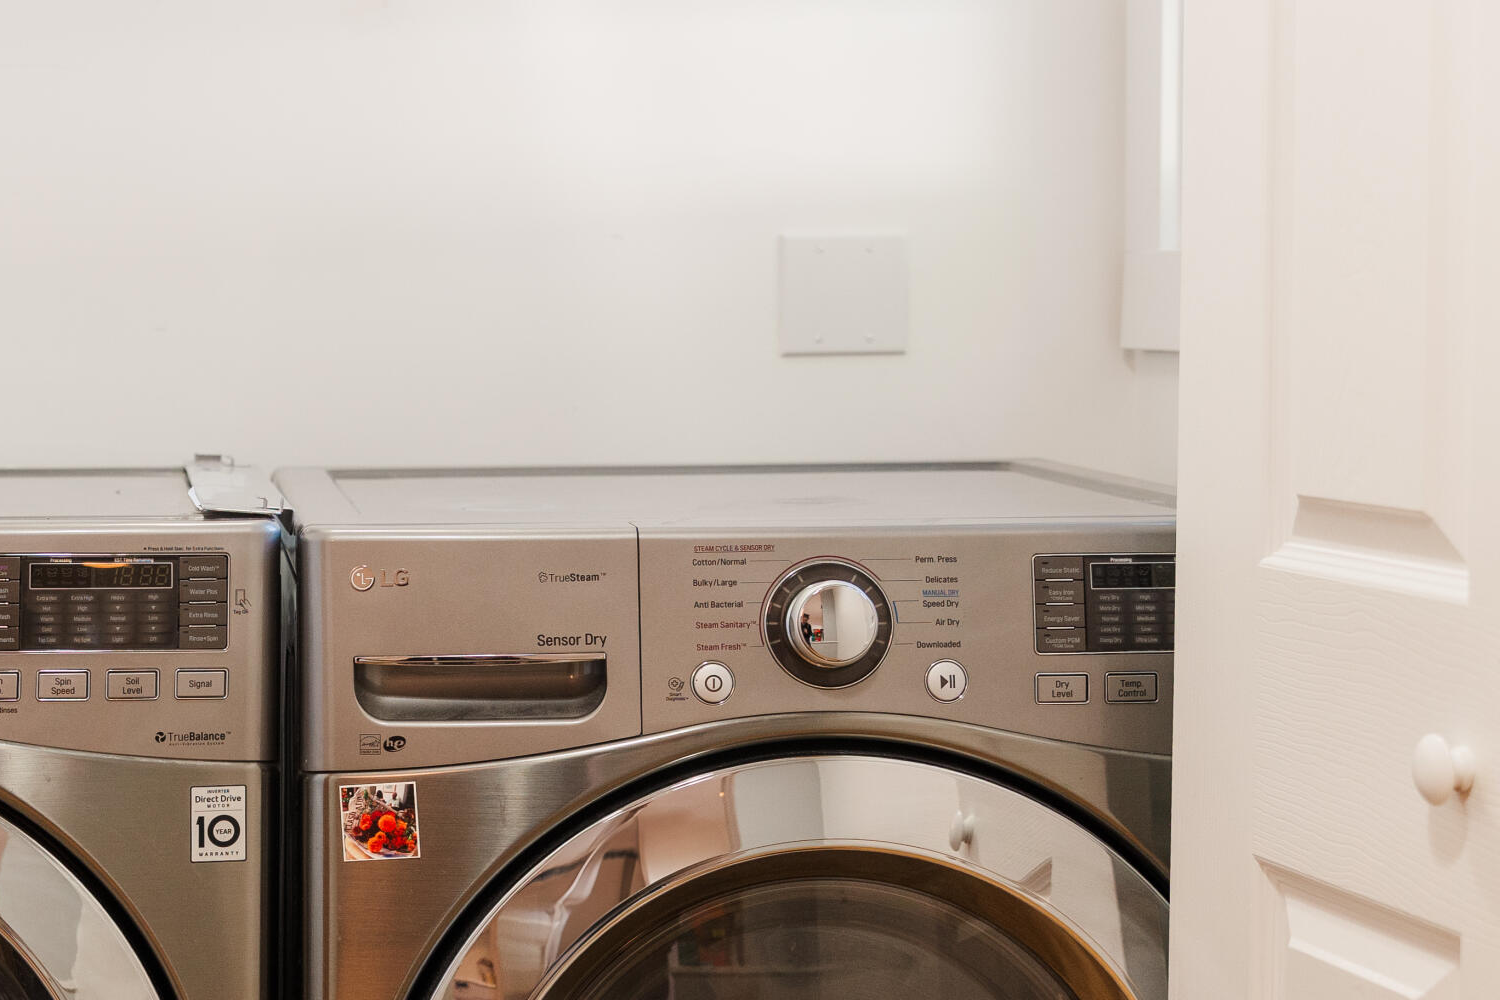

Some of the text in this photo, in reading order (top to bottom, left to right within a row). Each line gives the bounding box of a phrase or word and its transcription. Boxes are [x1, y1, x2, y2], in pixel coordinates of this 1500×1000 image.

[692, 558, 747, 567] Cotton/Normal
[915, 555, 958, 563] Perm. Press
[380, 569, 410, 588] LG
[693, 578, 737, 588] Bulky/Large
[925, 575, 959, 584] Delicates
[711, 600, 744, 608] Bacterial
[922, 599, 959, 608] Speed Dry
[695, 621, 718, 630] Steam
[935, 618, 960, 627] Air Dry
[537, 633, 607, 647] Sensor Dry
[916, 640, 961, 649] Downloaded
[696, 643, 720, 651] Steam
[54, 677, 71, 687] Spin
[125, 677, 140, 685] Soil
[189, 679, 212, 689] Signal
[1055, 680, 1070, 689] Dry
[51, 686, 75, 696] Speed
[122, 686, 142, 695] Level
[1052, 689, 1073, 698] Level
[1118, 688, 1146, 697] Control
[195, 794, 241, 804] Direct Drive
[196, 814, 241, 849] 10
